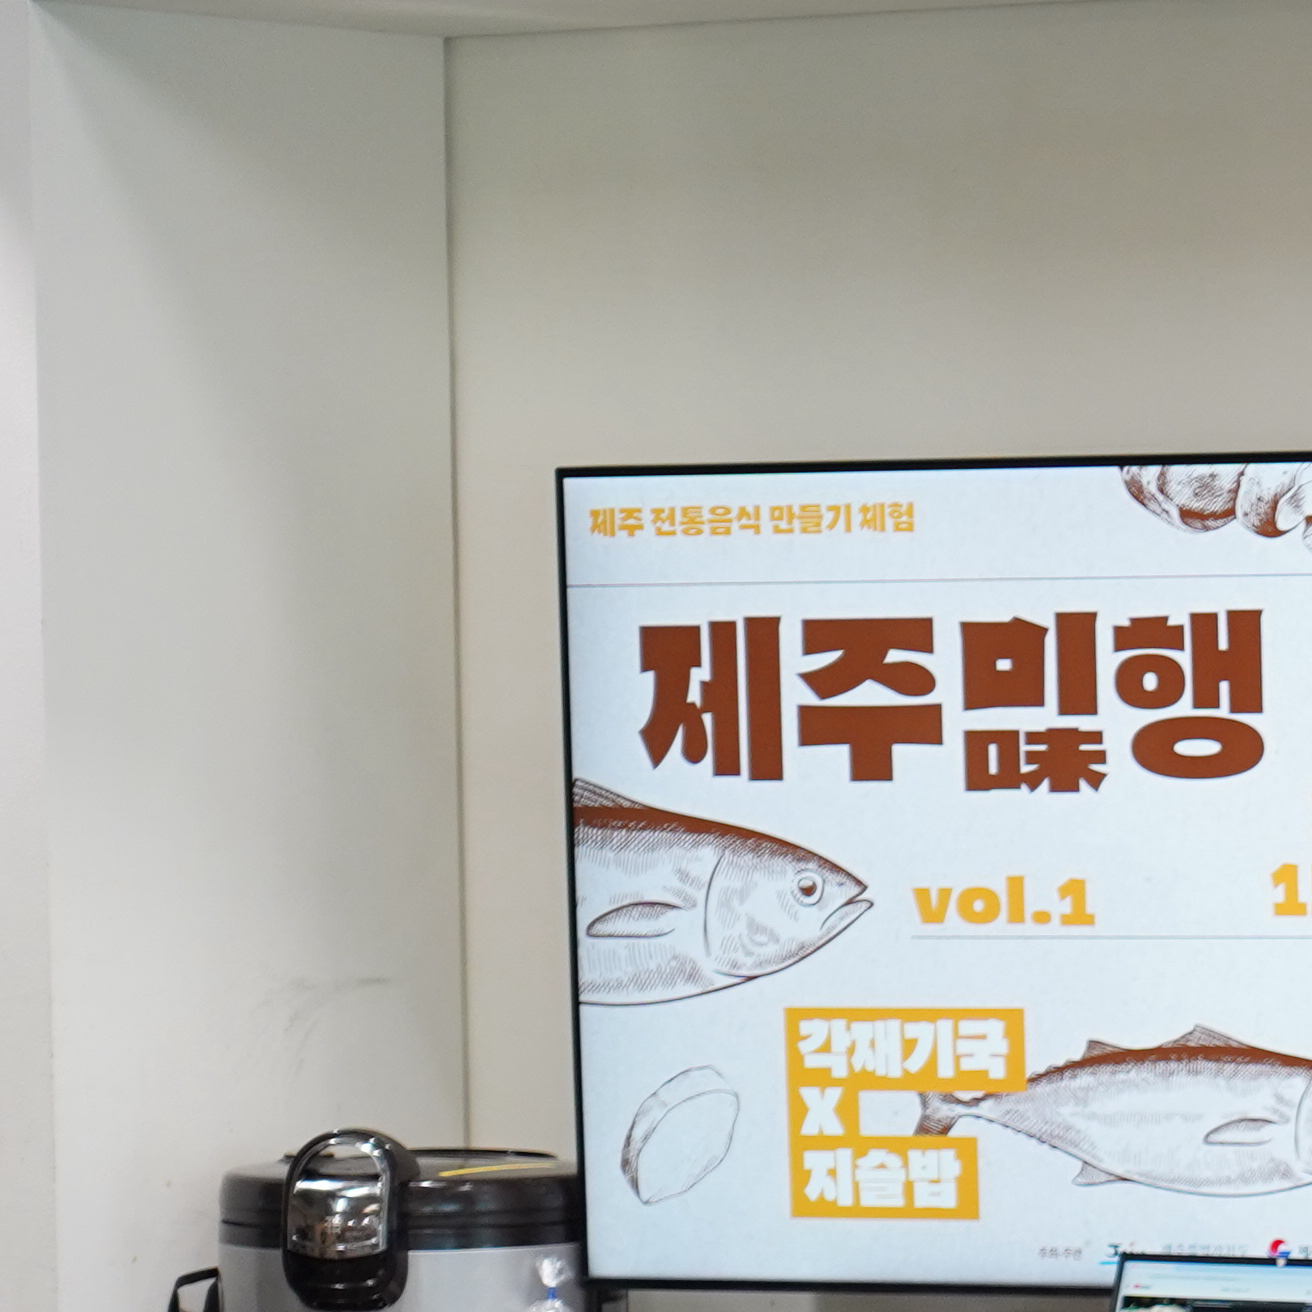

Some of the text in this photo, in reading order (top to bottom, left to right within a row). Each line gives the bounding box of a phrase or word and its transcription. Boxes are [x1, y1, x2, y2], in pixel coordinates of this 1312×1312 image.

[589, 501, 915, 537] 제주 전통음식 만들기 체험
[964, 727, 1107, 792] 味
[913, 876, 1096, 926] vol.1
[797, 1018, 1009, 1079] 각재기국
[800, 1087, 844, 1137] X
[803, 1147, 961, 1209] 지슬밥
